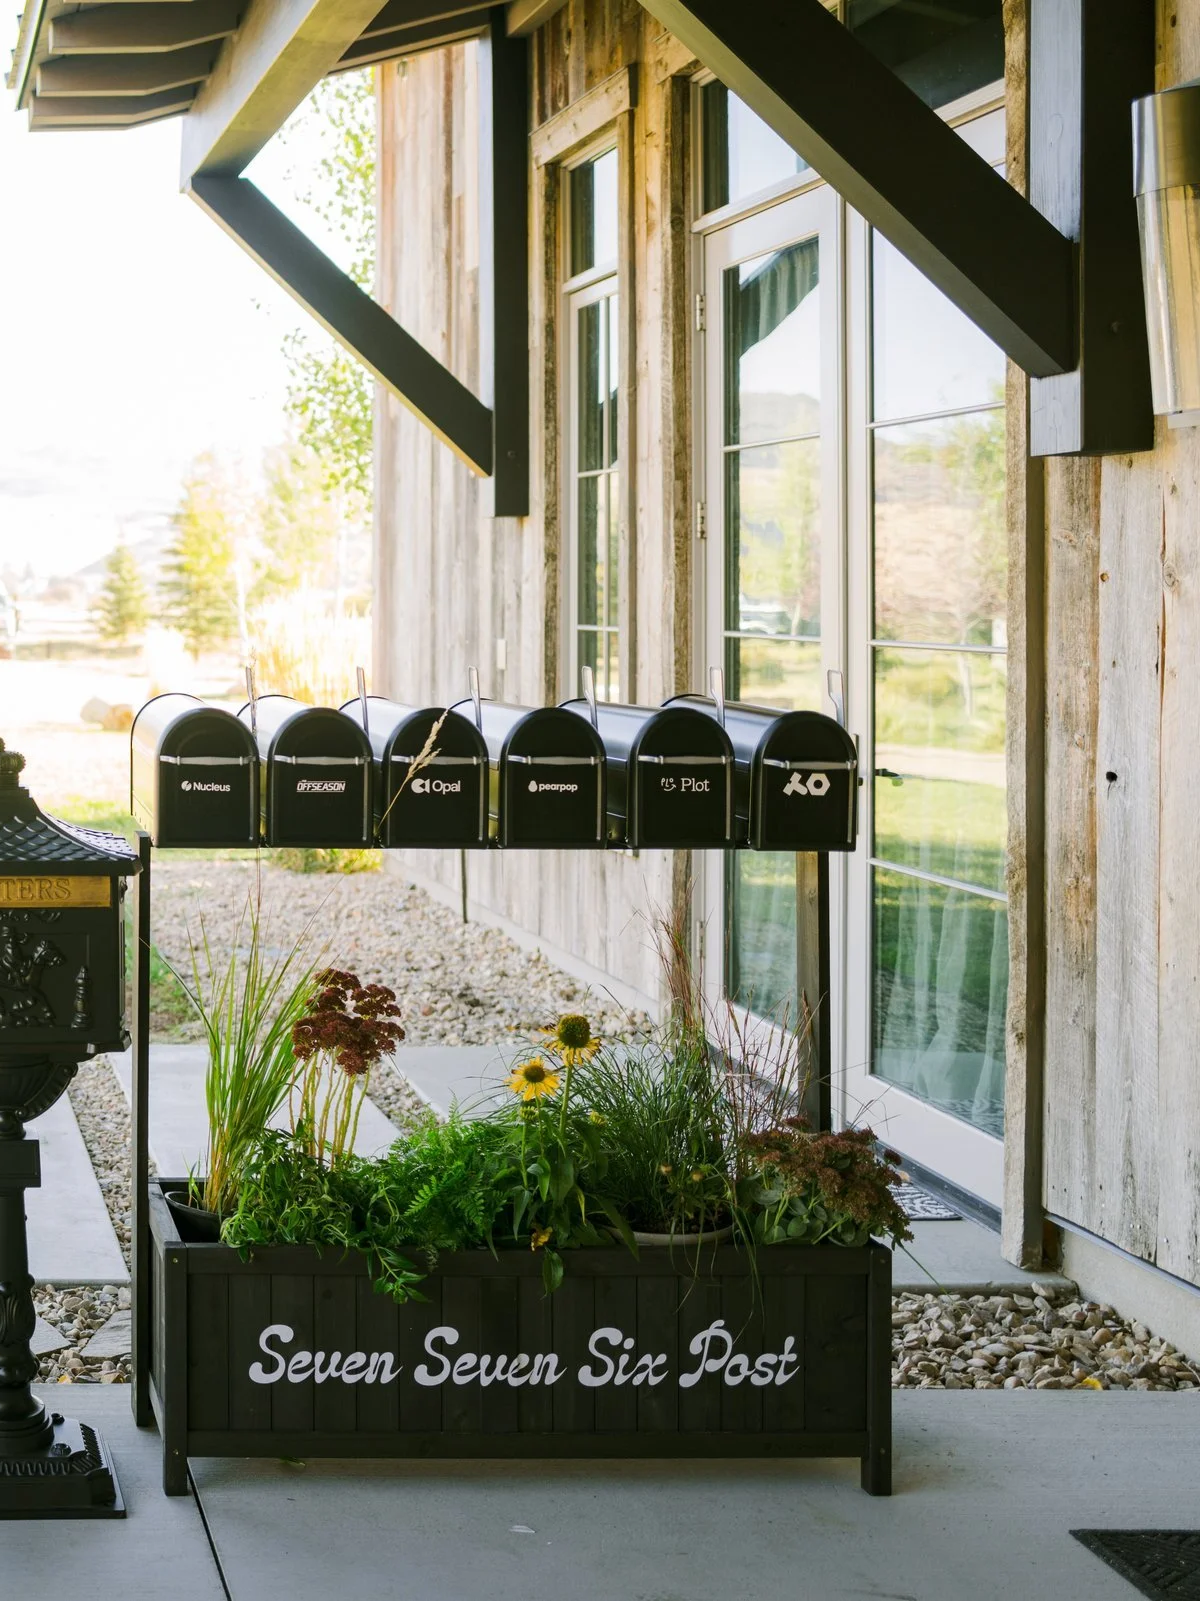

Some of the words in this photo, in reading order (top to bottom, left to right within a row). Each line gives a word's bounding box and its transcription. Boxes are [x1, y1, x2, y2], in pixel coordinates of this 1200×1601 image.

[192, 781, 231, 792] Nucleus
[297, 782, 346, 791] OFFSEASON
[431, 780, 461, 795] Opal
[538, 781, 578, 793] pearpop
[680, 777, 710, 792] Plot
[248, 1324, 404, 1385] Seven
[413, 1326, 568, 1387] Seven
[577, 1326, 669, 1387] Six
[678, 1319, 801, 1388] Post
